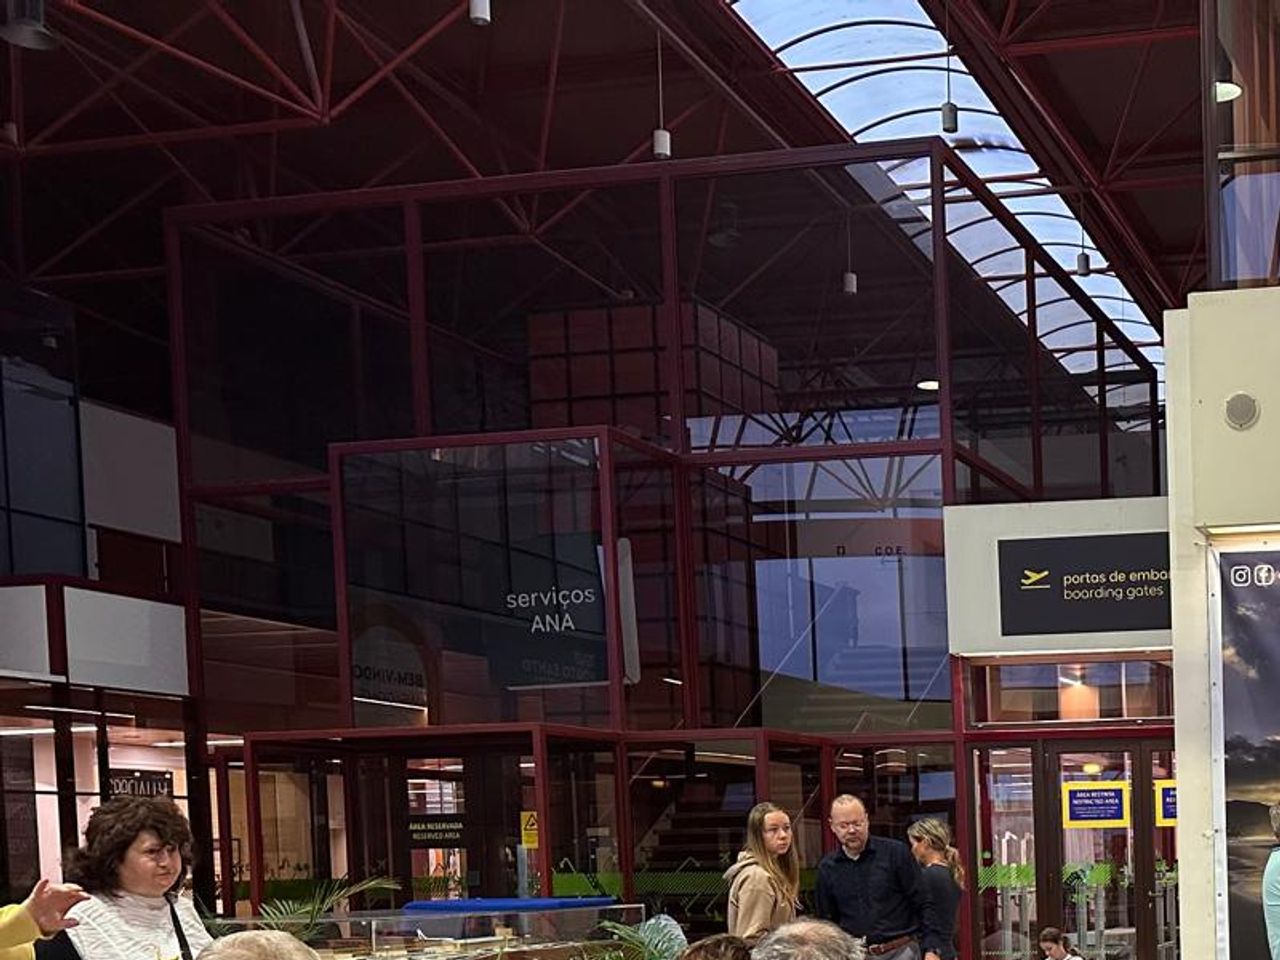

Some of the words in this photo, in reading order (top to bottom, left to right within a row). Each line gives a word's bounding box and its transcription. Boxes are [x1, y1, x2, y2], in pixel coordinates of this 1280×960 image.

[1063, 573, 1106, 587] portas
[1108, 570, 1126, 582] de
[1129, 568, 1170, 581] emba
[506, 586, 595, 608] serviços
[1063, 586, 1123, 601] boarding
[1126, 585, 1164, 599] gates
[531, 614, 575, 634] ANA
